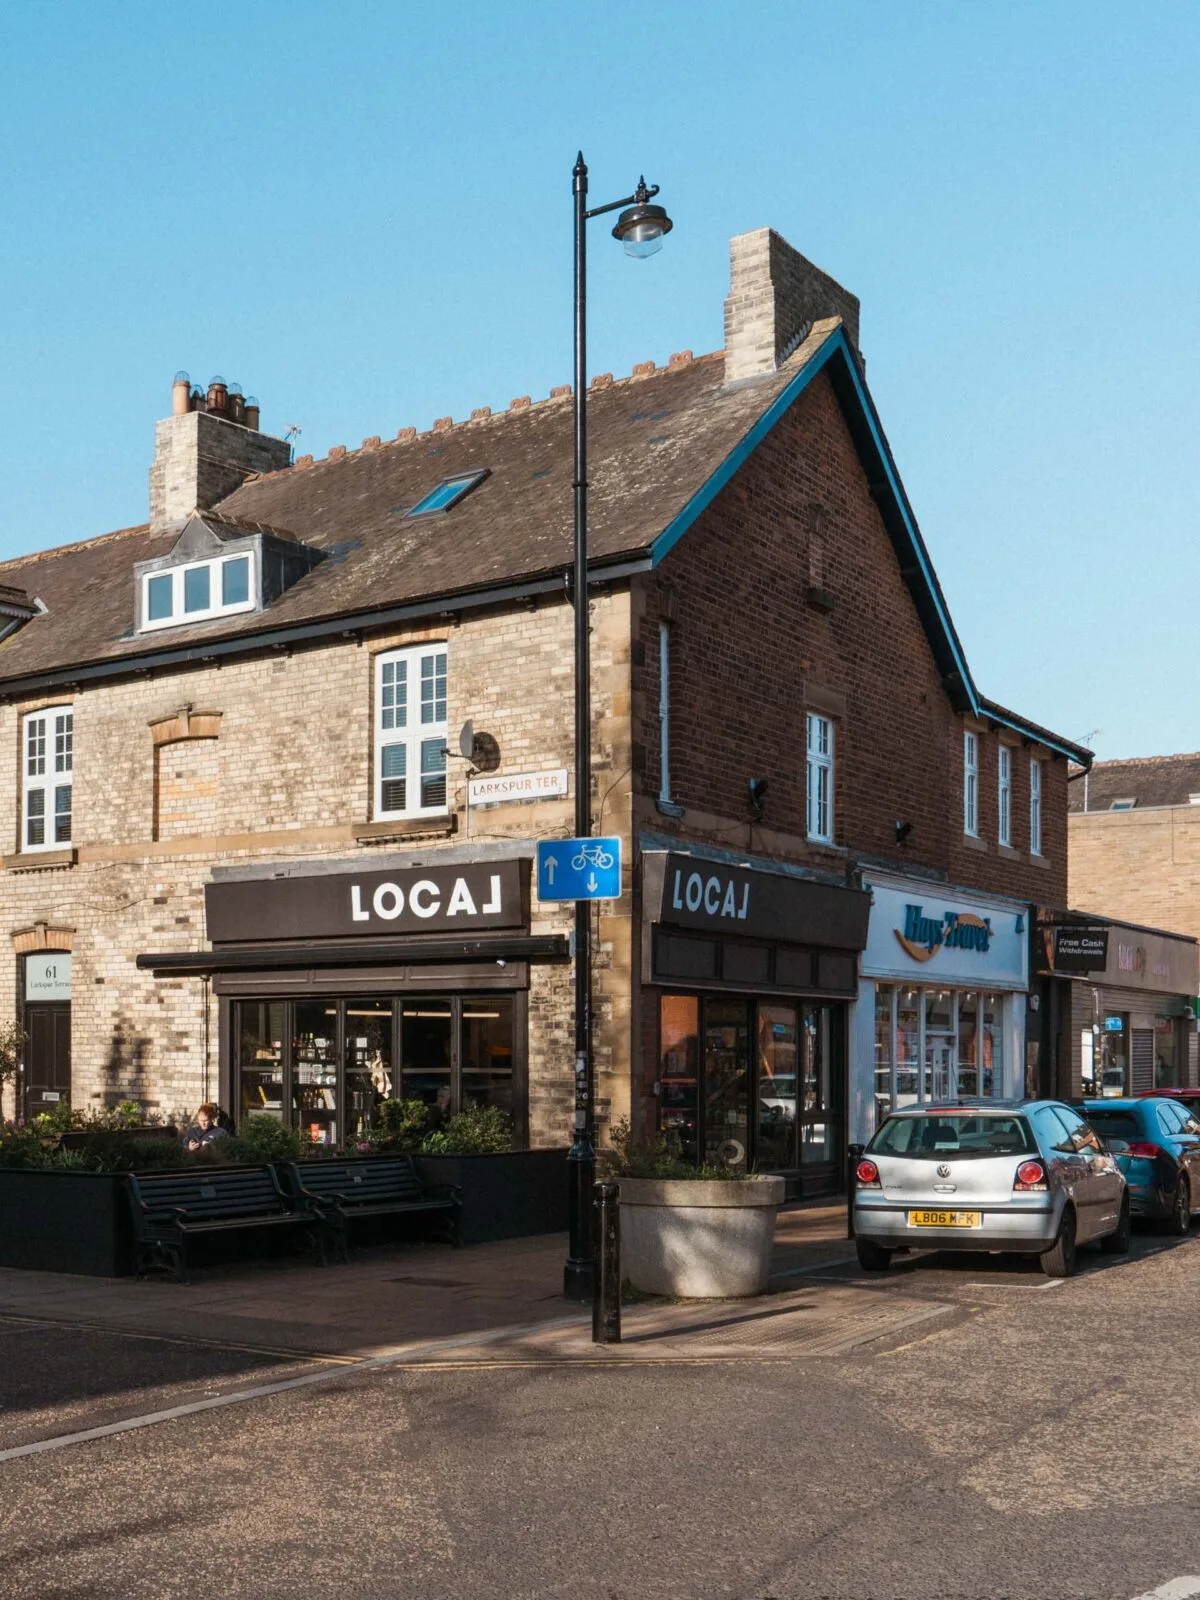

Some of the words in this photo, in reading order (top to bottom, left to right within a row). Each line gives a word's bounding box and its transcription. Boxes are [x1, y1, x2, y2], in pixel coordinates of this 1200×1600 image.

[473, 780, 532, 796] LARKSPUR
[536, 776, 559, 788] TER
[351, 875, 502, 921] LOCAL
[673, 870, 750, 919] LOCAL
[904, 904, 944, 955] Hays
[944, 911, 991, 953] Travel
[1058, 947, 1103, 956] Withdrawals
[1059, 938, 1079, 947] Free
[1081, 938, 1104, 948] Cash
[45, 965, 57, 979] 61
[914, 1211, 947, 1224] LB06
[949, 1212, 975, 1225] MFK
